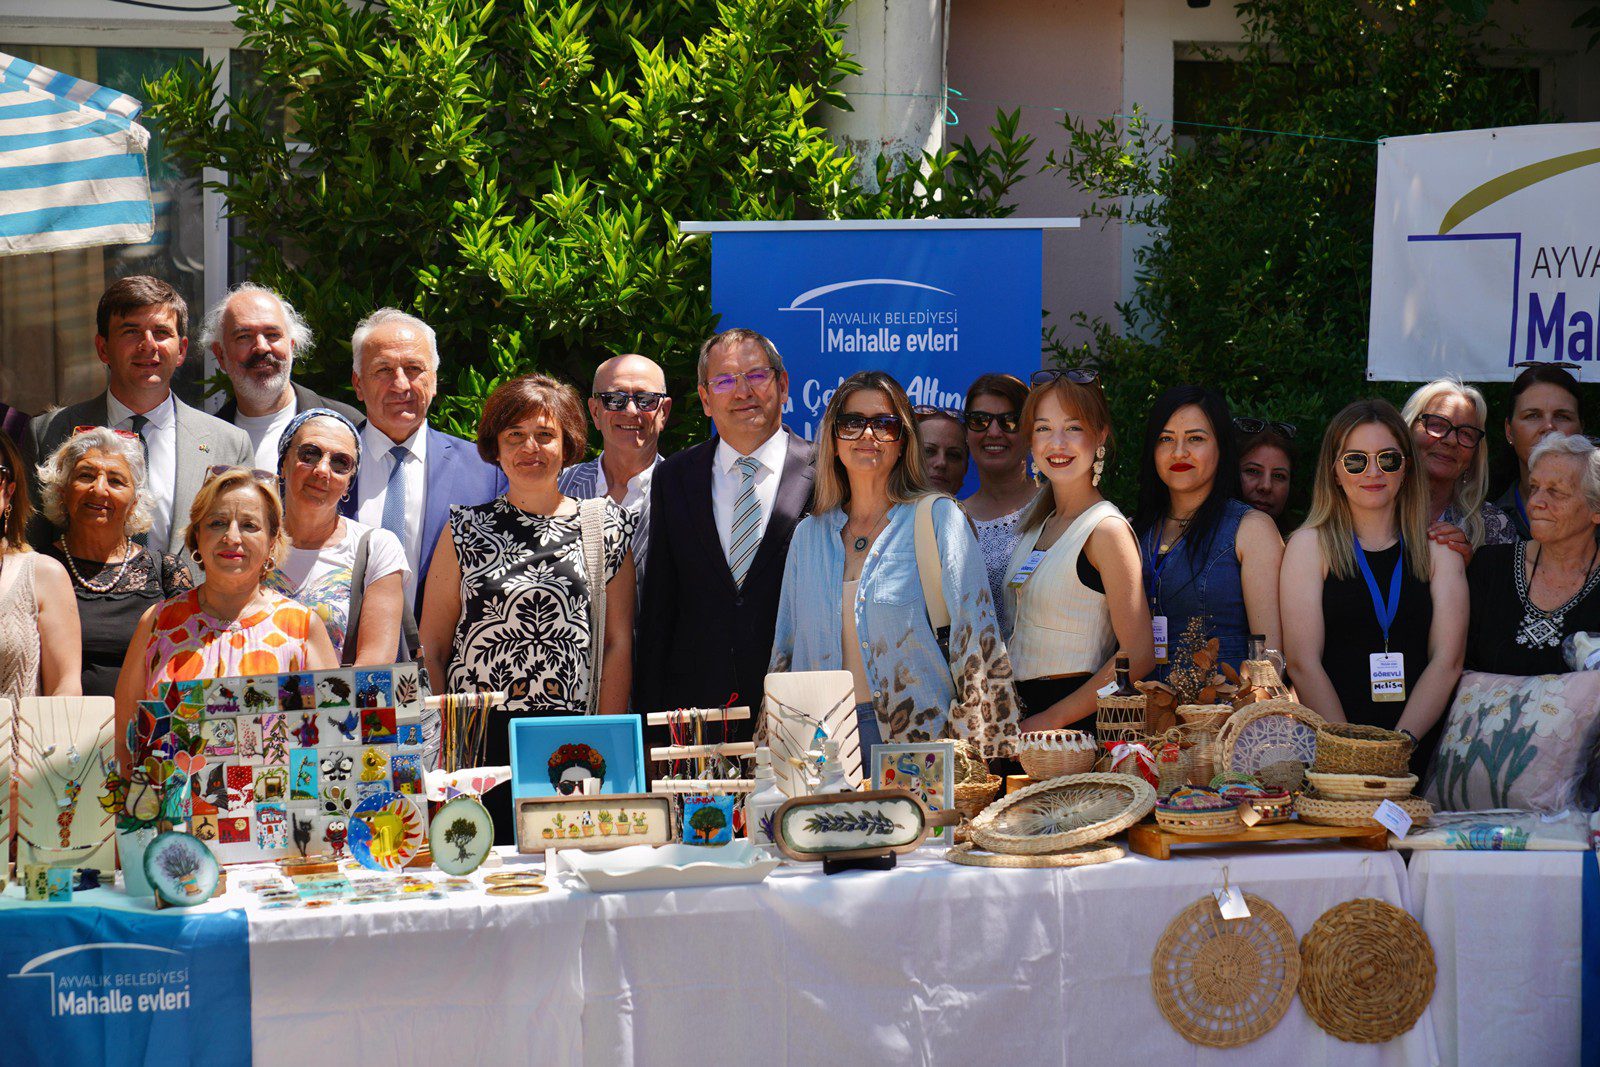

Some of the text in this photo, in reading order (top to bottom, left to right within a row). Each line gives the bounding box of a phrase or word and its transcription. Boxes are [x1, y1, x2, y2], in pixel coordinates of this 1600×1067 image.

[828, 308, 958, 325] AYVALIK BELEDİYESİ
[1525, 291, 1600, 362] Ma
[828, 327, 958, 352] Mahalle evleri
[905, 375, 968, 411] Altın
[59, 967, 190, 988] AYVALIK BELEDİYESİ
[58, 984, 191, 1016] Mahalle evleri
